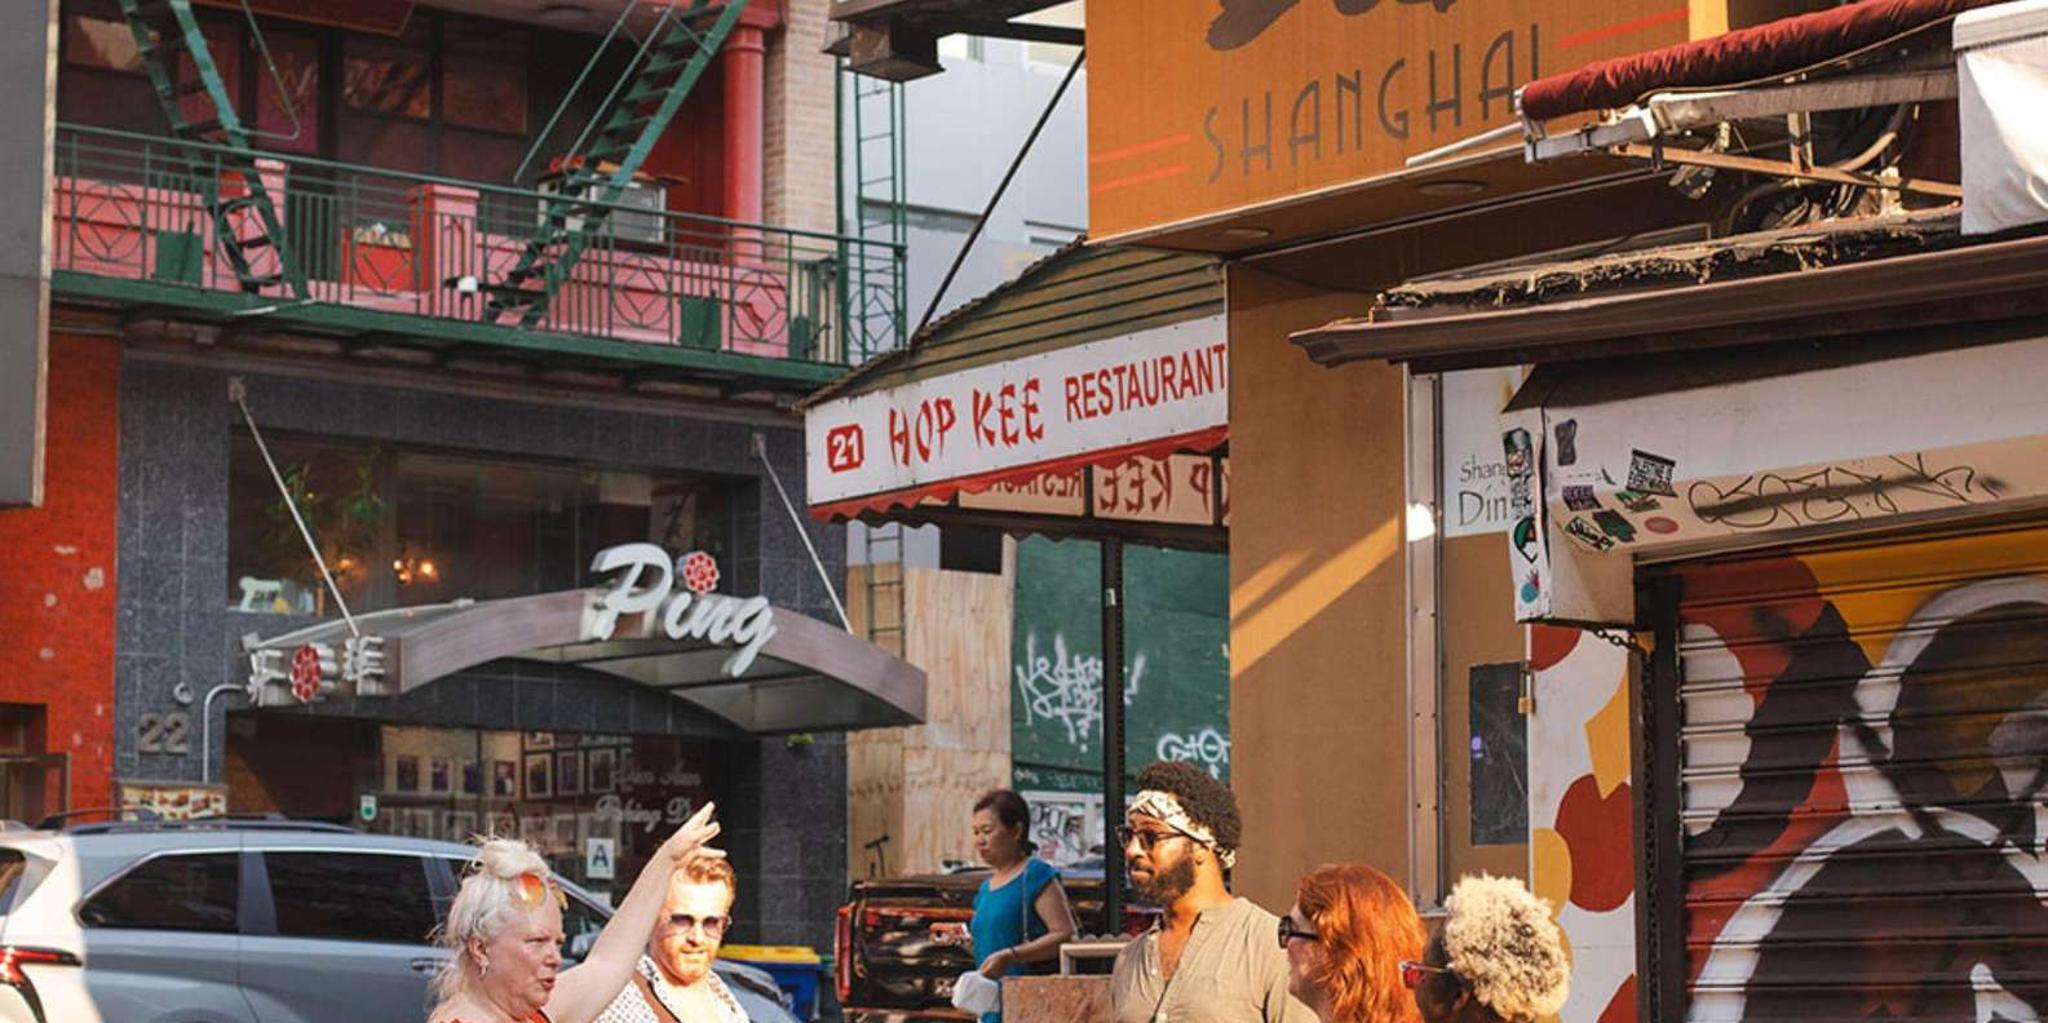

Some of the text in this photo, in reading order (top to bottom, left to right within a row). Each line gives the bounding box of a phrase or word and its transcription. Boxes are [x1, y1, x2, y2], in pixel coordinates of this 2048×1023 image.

[1205, 23, 1538, 184] SHANGHAI
[832, 343, 1228, 467] 21 HOP KEE RESTAURANT
[1460, 454, 1506, 483] Shan
[591, 542, 778, 677] Ping
[139, 711, 190, 756] 22
[591, 844, 609, 868] A
